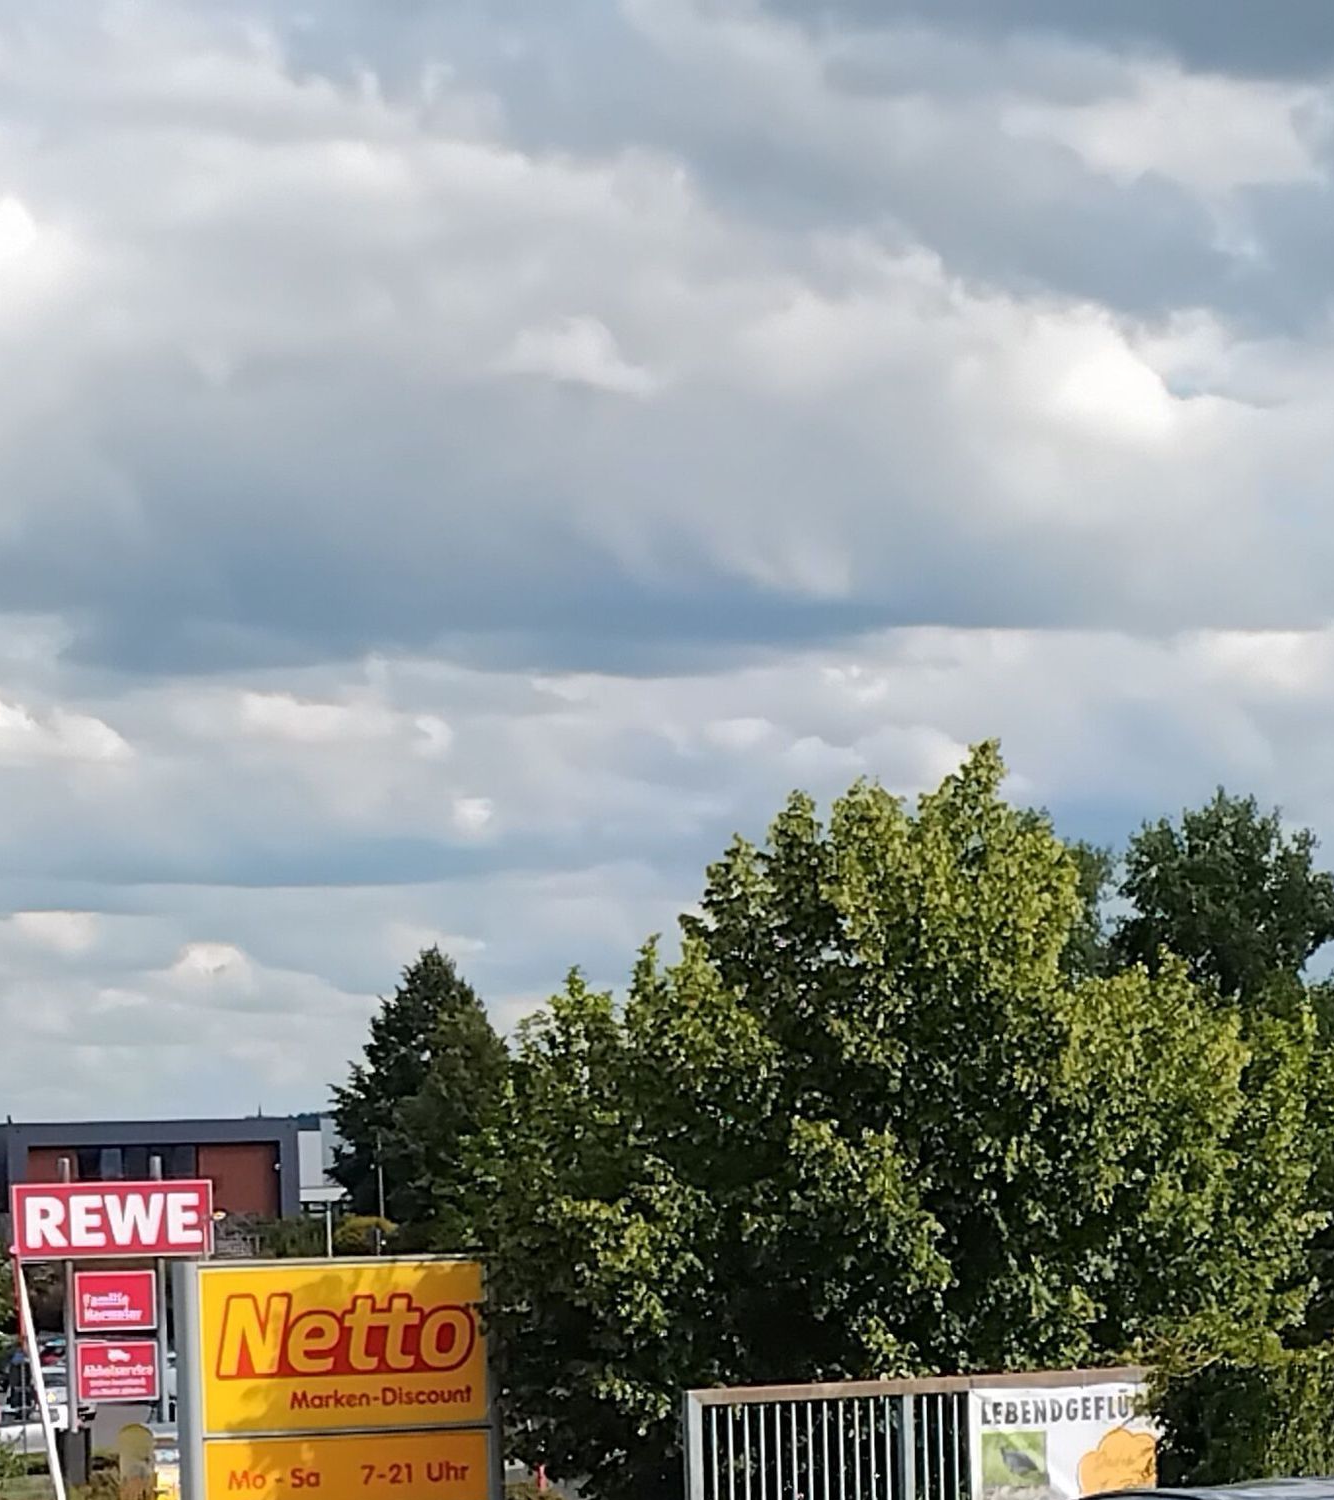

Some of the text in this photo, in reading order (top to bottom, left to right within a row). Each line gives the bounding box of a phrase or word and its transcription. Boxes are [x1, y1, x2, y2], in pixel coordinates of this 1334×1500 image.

[25, 1193, 203, 1248] REWE
[216, 1292, 475, 1380] Netto
[290, 1385, 472, 1410] Marken-Discount
[227, 1470, 267, 1490] Mo
[290, 1468, 321, 1488] Sa
[360, 1463, 414, 1485] 7-21
[427, 1461, 469, 1483] Uhr
